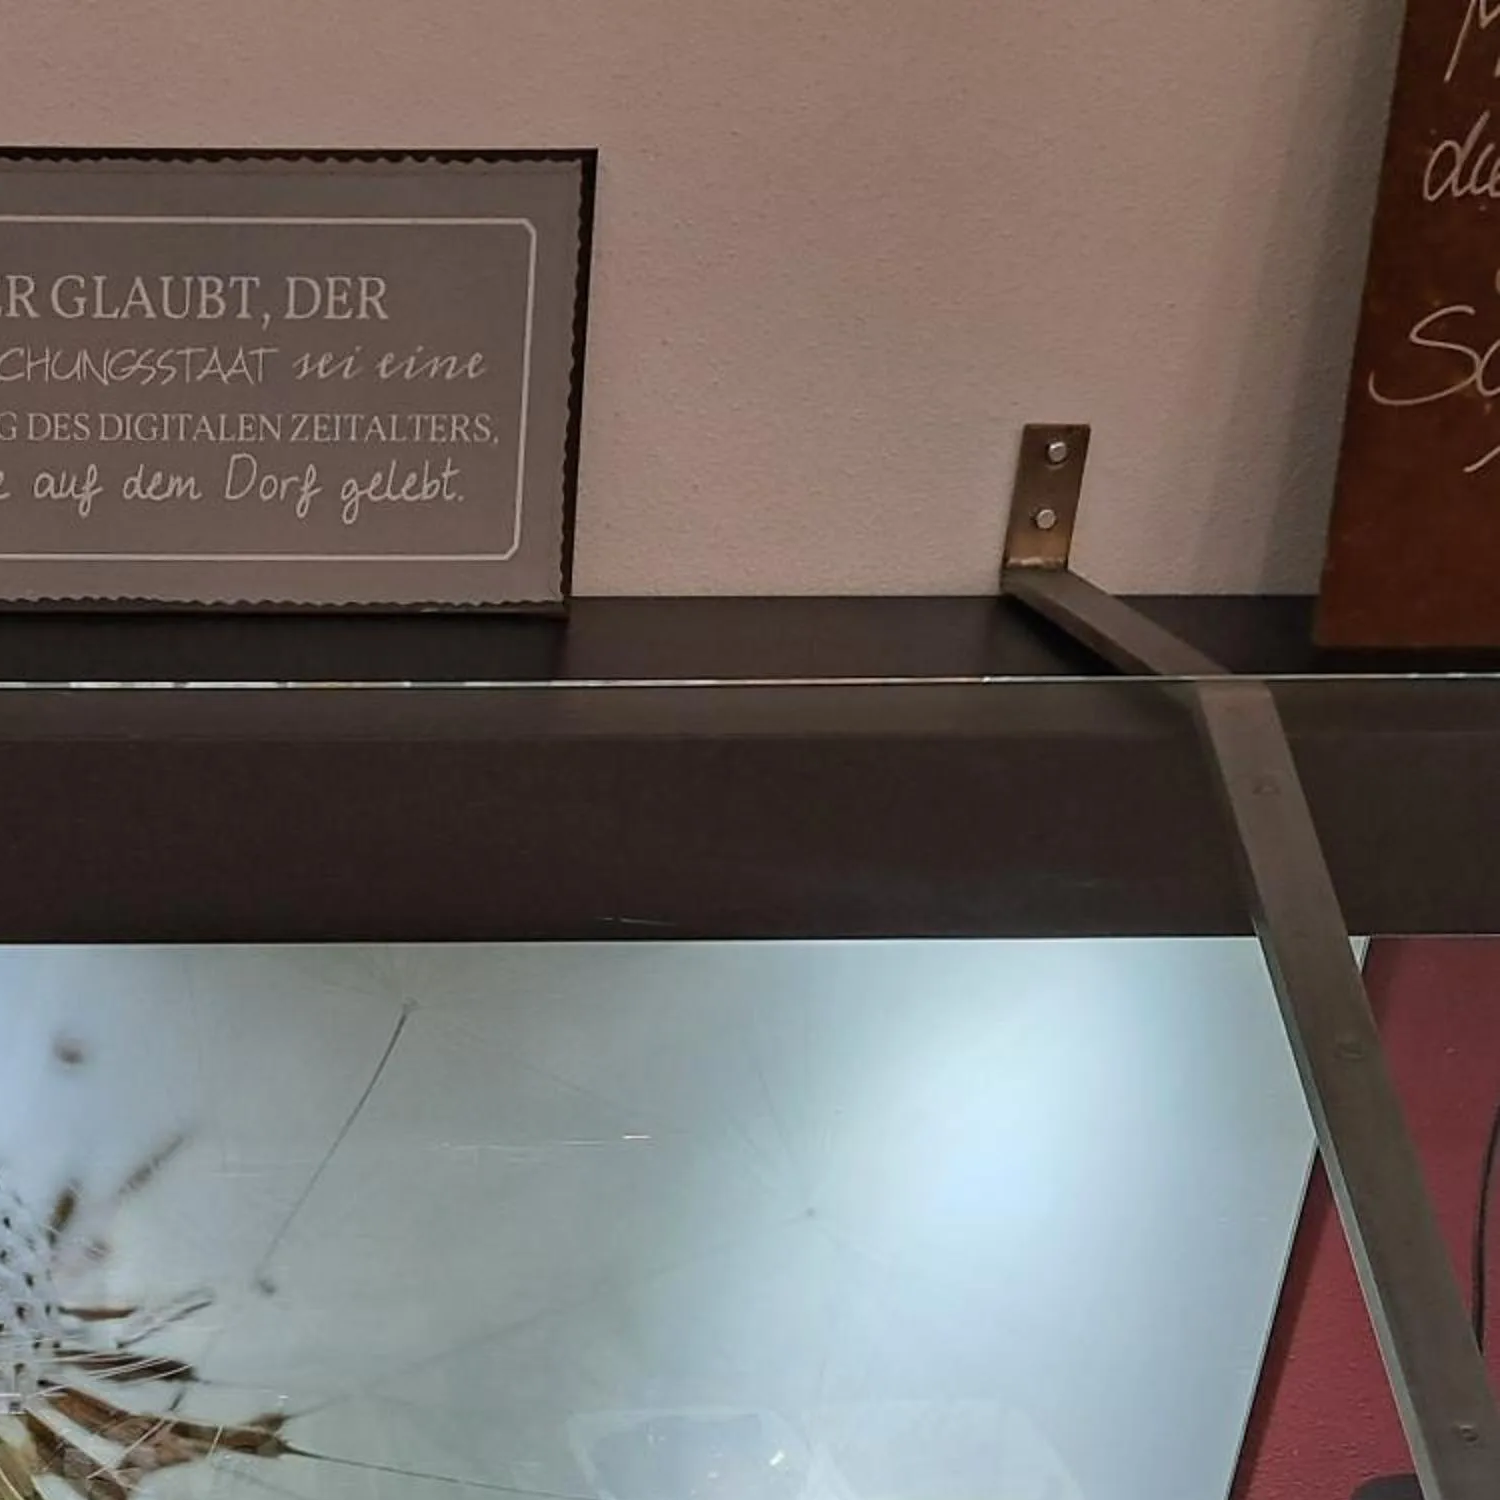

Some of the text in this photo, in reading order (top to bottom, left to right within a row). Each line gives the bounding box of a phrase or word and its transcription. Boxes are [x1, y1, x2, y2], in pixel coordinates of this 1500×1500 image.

[50, 273, 272, 332] GLAUBT,
[283, 275, 389, 320] DER
[292, 345, 366, 381] sei
[374, 345, 488, 381] eine
[27, 411, 92, 442] DES
[99, 412, 283, 443] DIGITALEN
[33, 463, 104, 518] auf
[122, 463, 203, 501] dem
[224, 453, 324, 519] Dorf
[340, 457, 466, 525] gelebt.
